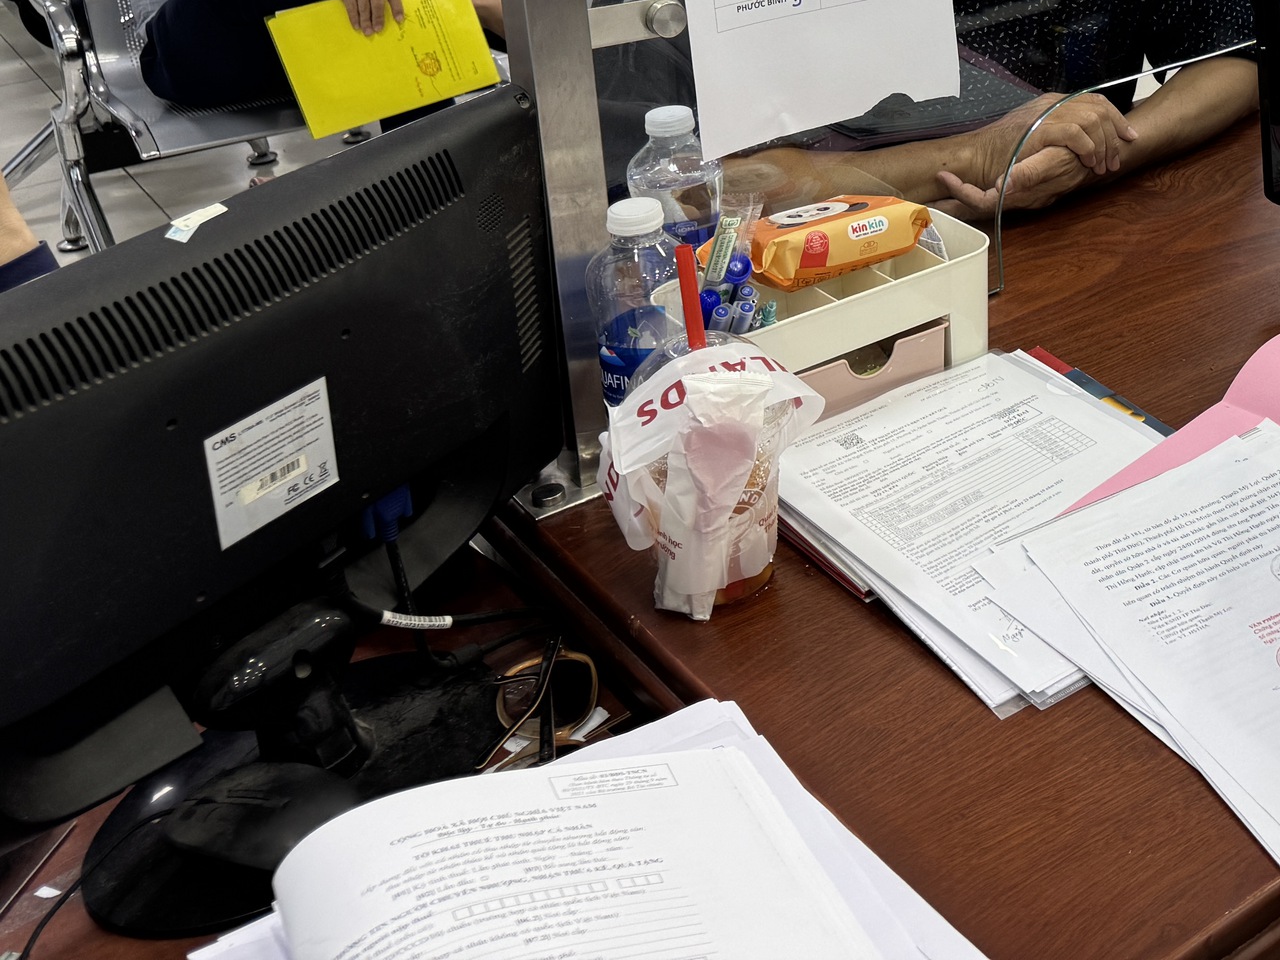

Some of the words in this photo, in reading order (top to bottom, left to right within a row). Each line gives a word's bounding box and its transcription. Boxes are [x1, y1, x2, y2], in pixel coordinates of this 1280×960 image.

[736, 0, 766, 13] PHƯỚC
[850, 217, 886, 235] kinkin
[212, 432, 237, 452] CMS
[303, 473, 315, 485] CE
